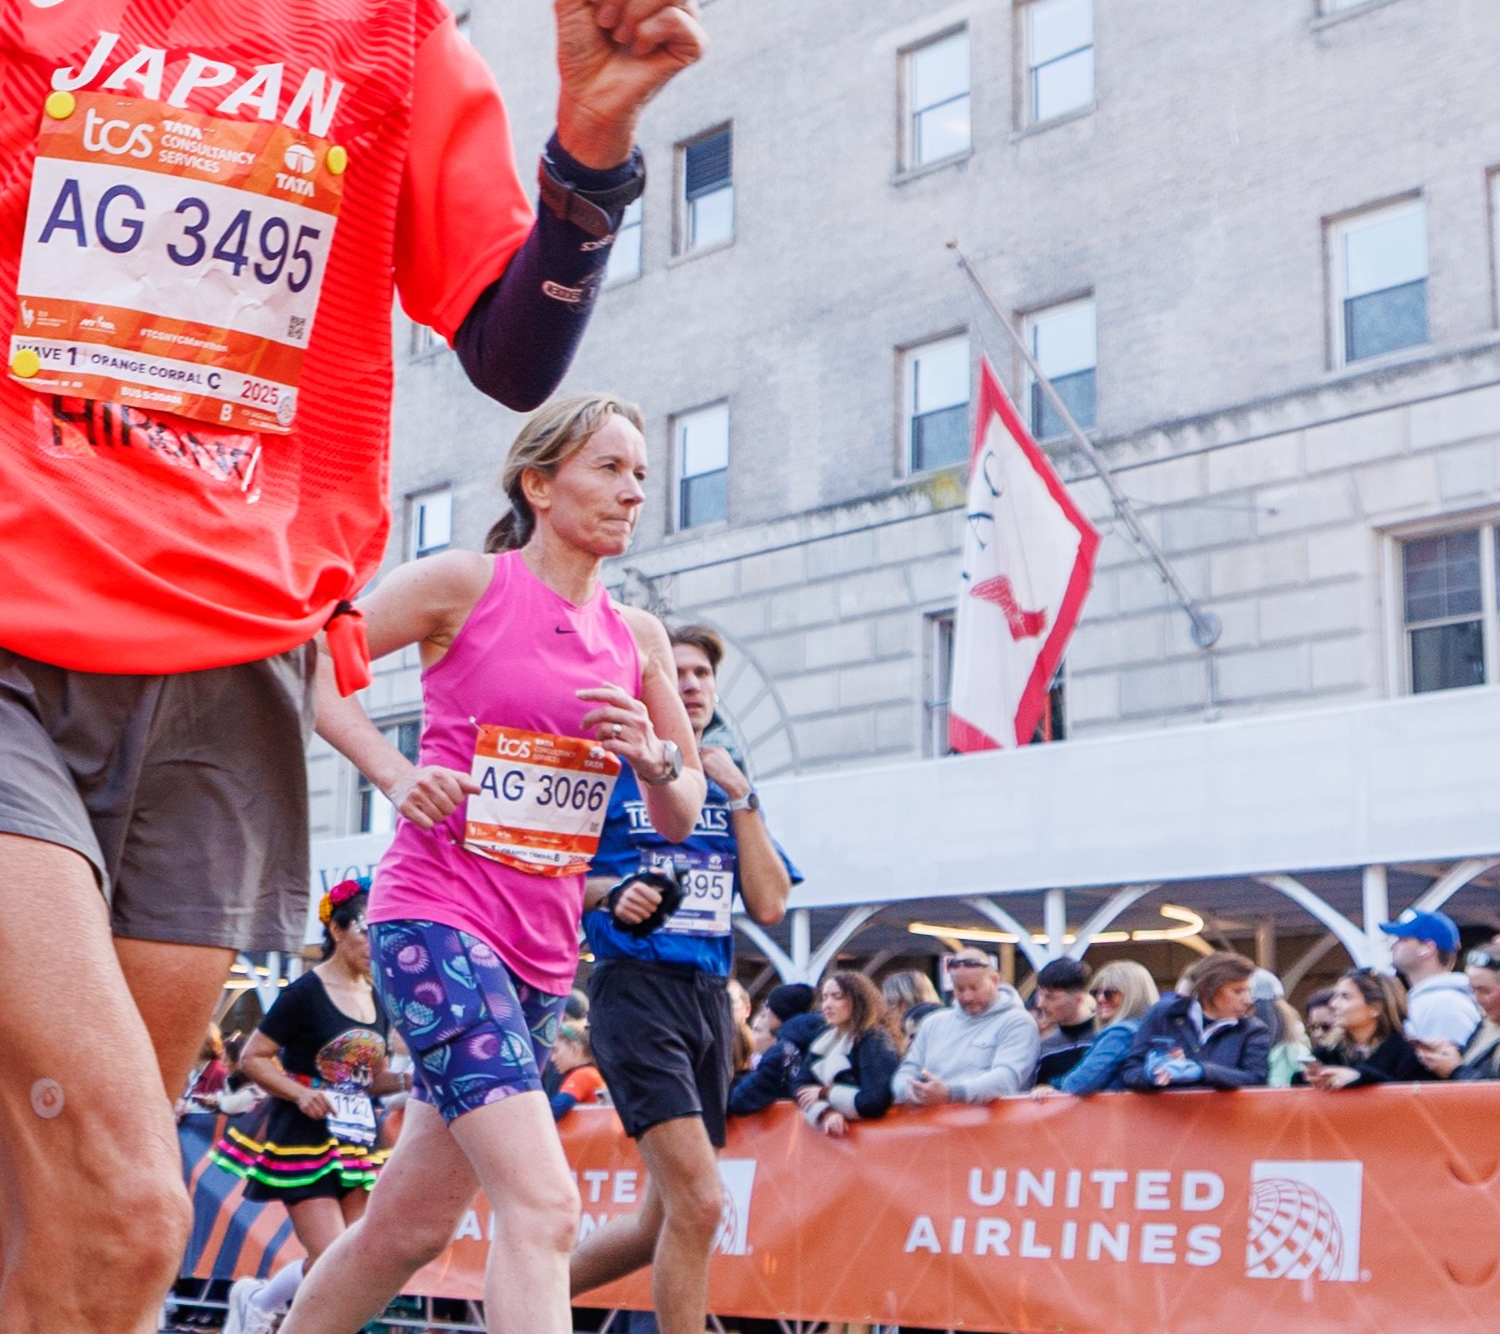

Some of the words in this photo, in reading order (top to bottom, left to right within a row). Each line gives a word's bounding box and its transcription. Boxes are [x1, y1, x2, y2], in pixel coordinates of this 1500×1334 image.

[51, 29, 345, 138] JAPAN
[83, 107, 154, 158] tcs
[160, 134, 256, 166] CONSULTANCY
[163, 119, 204, 141] TATA
[158, 150, 221, 174] SERVICES
[275, 171, 316, 198] TATA
[38, 178, 146, 254] AG
[166, 197, 322, 294] 3495
[66, 347, 78, 366] 1
[90, 353, 148, 374] ORANGE
[148, 365, 203, 385] CORRAL
[207, 372, 222, 390] C
[240, 379, 280, 406] 2025
[496, 732, 531, 759] tcs
[481, 766, 526, 802] AG
[536, 774, 607, 812] 3066
[968, 1167, 1225, 1212] UNITED
[903, 1214, 1223, 1267] AIRLINES
